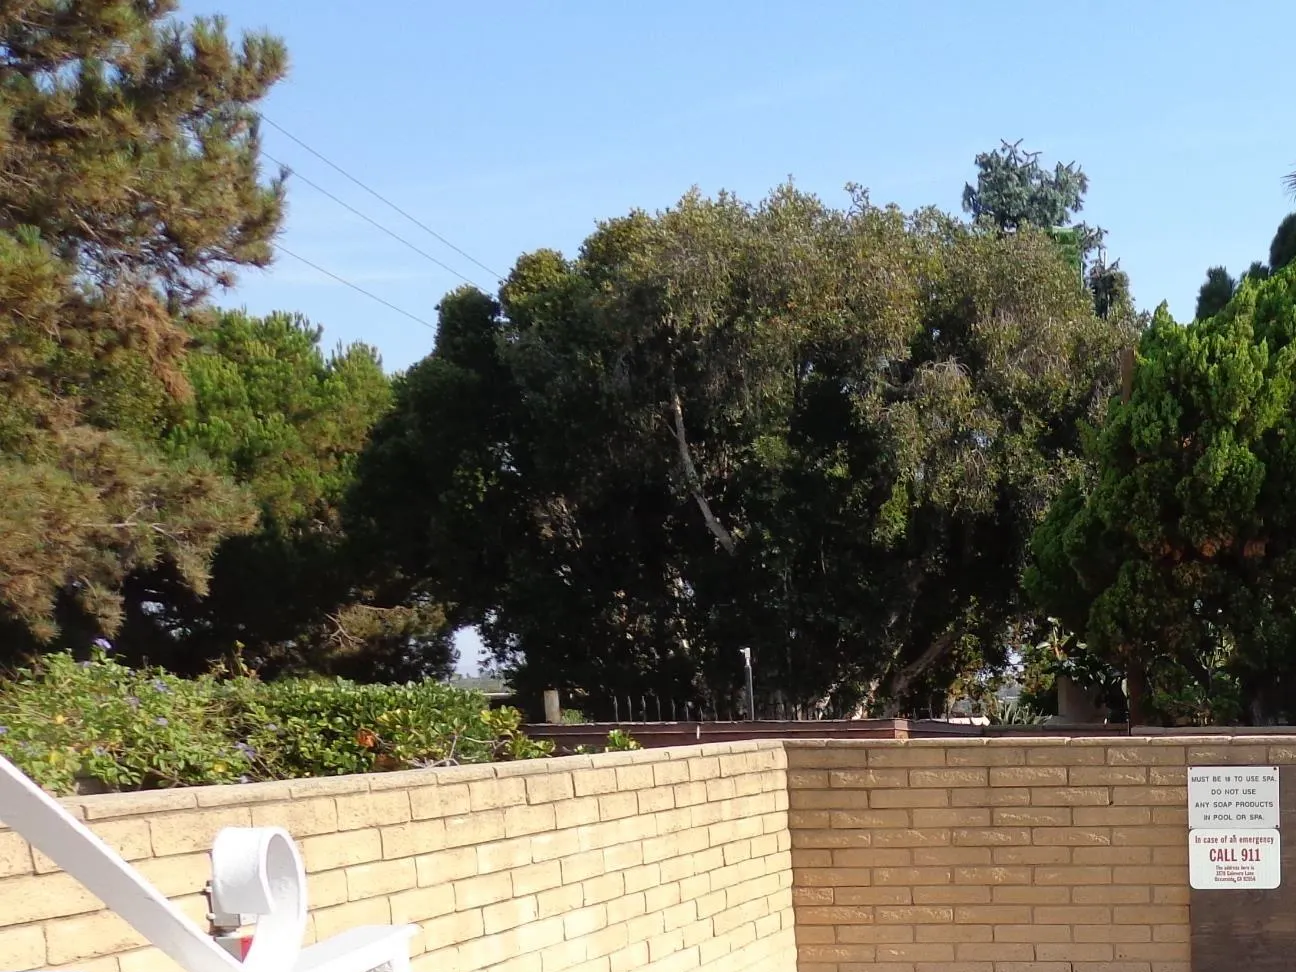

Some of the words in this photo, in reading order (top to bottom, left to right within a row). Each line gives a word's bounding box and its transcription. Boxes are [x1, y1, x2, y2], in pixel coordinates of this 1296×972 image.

[1191, 775, 1209, 783] MUST
[1195, 835, 1202, 843] In
[1220, 835, 1227, 843] of
[1239, 836, 1274, 845] emergency
[1209, 848, 1238, 862] CALL
[1241, 848, 1261, 862] 911
